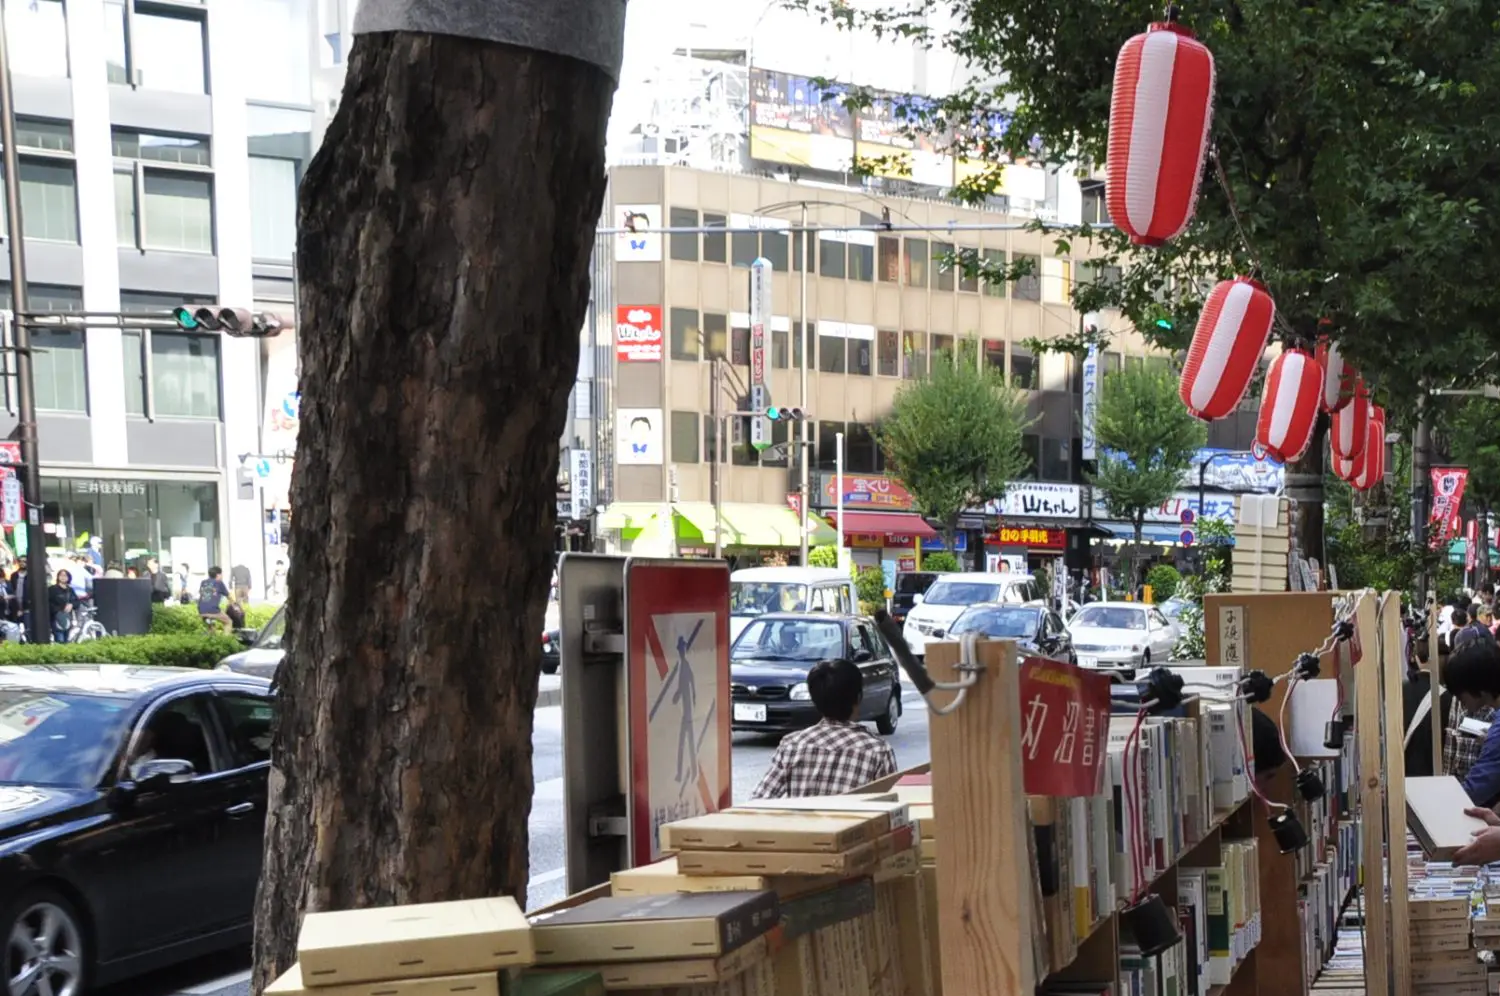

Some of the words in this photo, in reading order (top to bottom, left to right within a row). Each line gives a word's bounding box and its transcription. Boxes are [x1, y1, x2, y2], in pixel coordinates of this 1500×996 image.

[76, 481, 147, 496] 三井住友銀行
[852, 478, 890, 493] 宝くじ
[1022, 494, 1077, 515] 山ちゃん
[1000, 528, 1048, 543] 幻の手羽先
